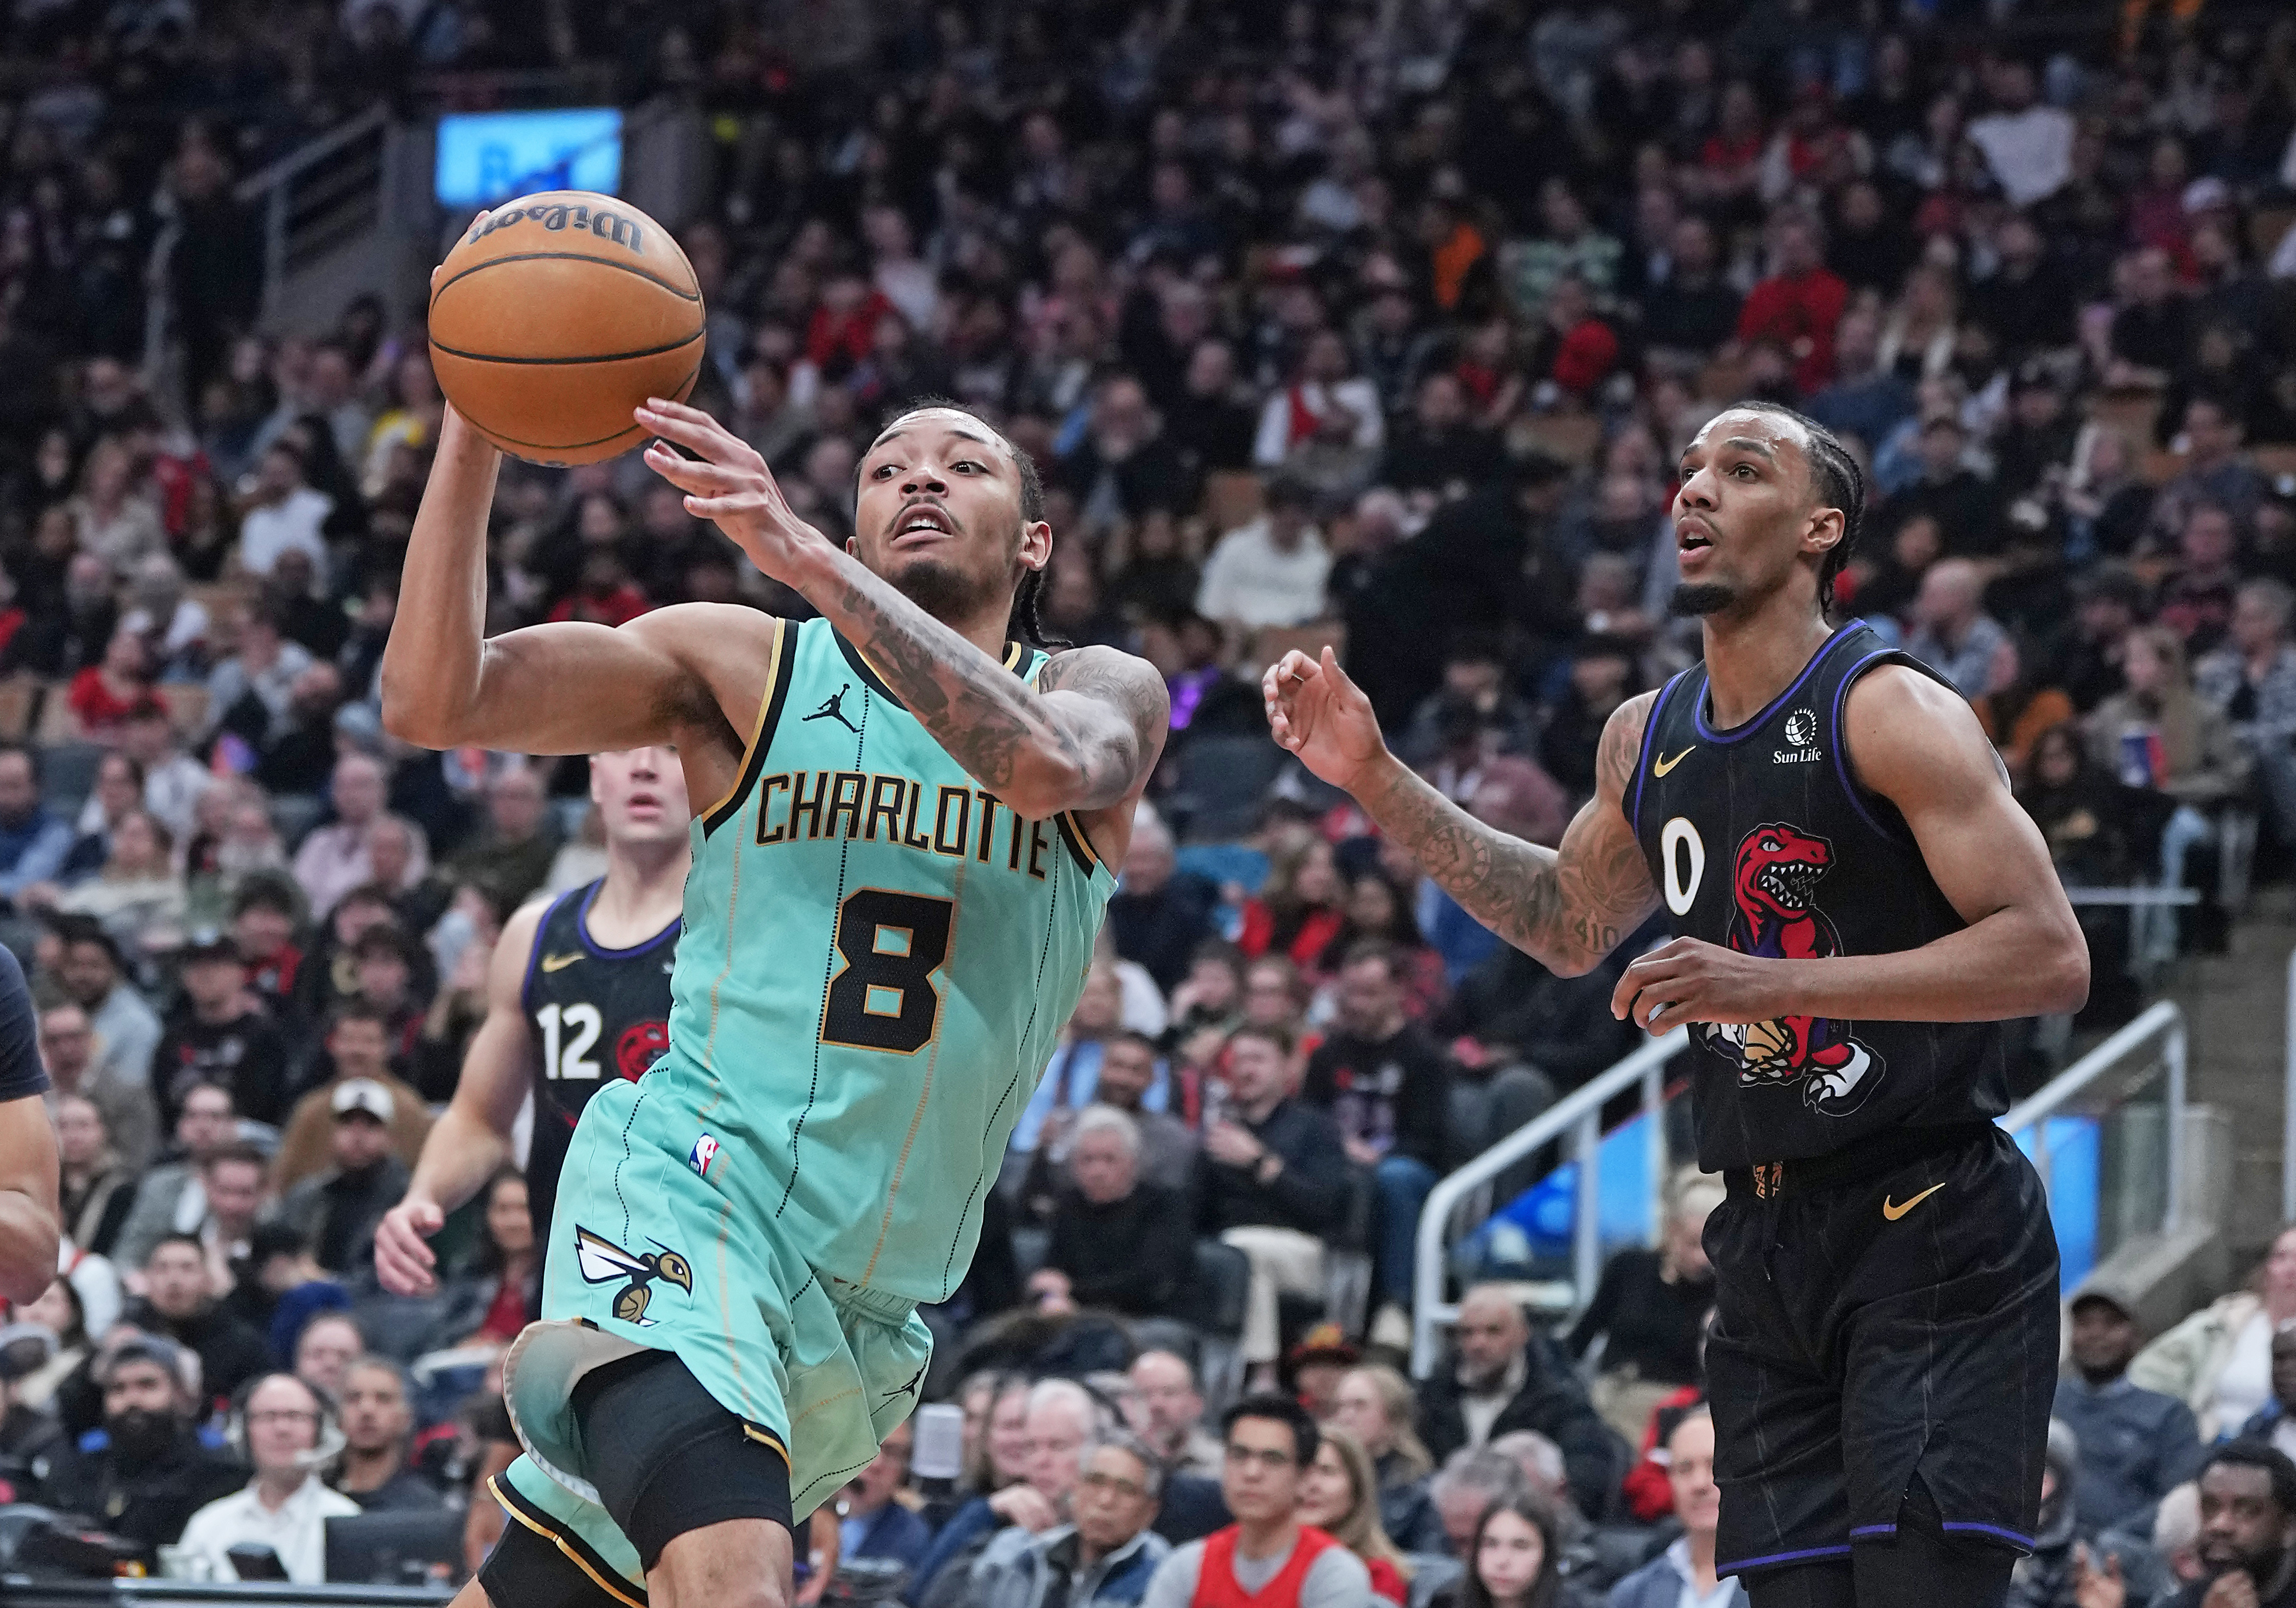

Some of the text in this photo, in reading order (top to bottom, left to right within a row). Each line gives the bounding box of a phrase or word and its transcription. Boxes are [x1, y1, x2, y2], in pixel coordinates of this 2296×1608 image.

[468, 204, 643, 255] Wilson
[1773, 747, 1822, 764] Sun Life
[754, 770, 1050, 882] CHARLOTTE
[1661, 817, 1705, 916] 0
[819, 886, 955, 1056] 8
[536, 1002, 602, 1080] 12
